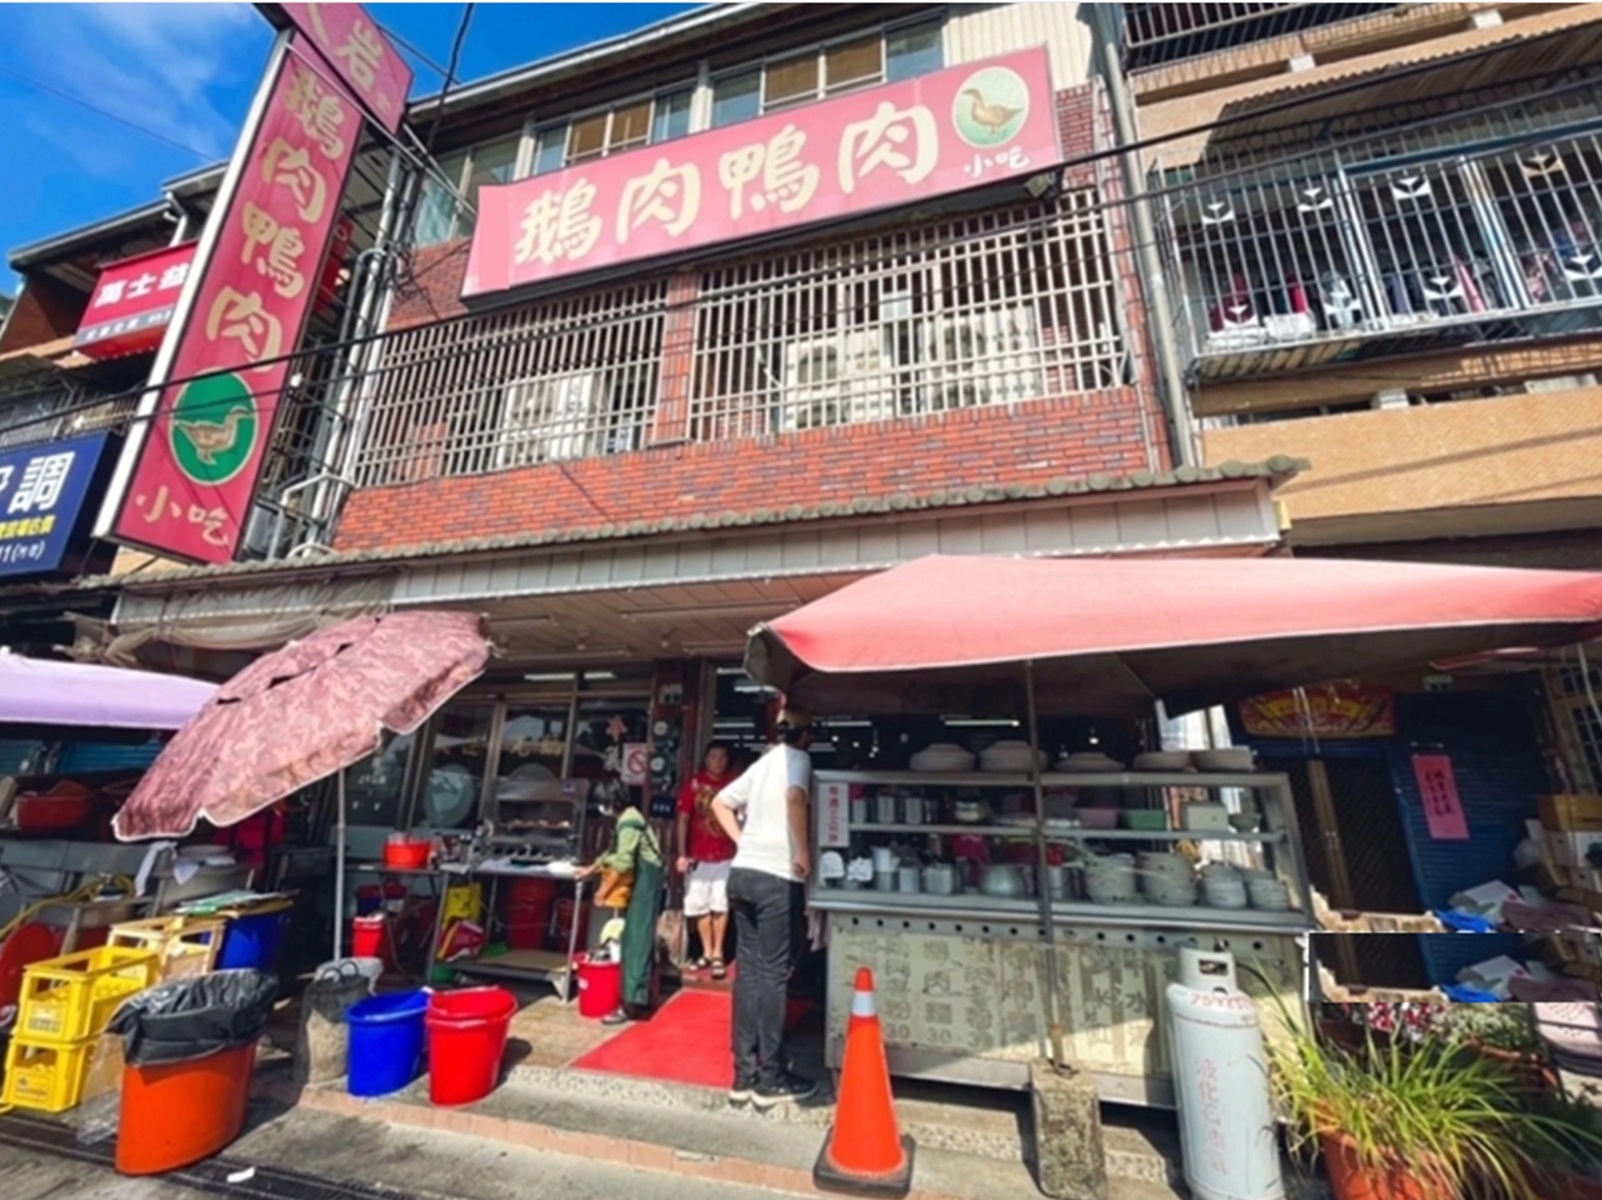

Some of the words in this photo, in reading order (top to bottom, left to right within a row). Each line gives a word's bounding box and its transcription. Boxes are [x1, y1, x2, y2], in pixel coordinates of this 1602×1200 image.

[514, 101, 939, 265] 鵝肉鴨肉
[962, 144, 1031, 178] 小吃
[205, 68, 345, 374] 鵝肉鴨肉
[136, 485, 228, 547] 小吃
